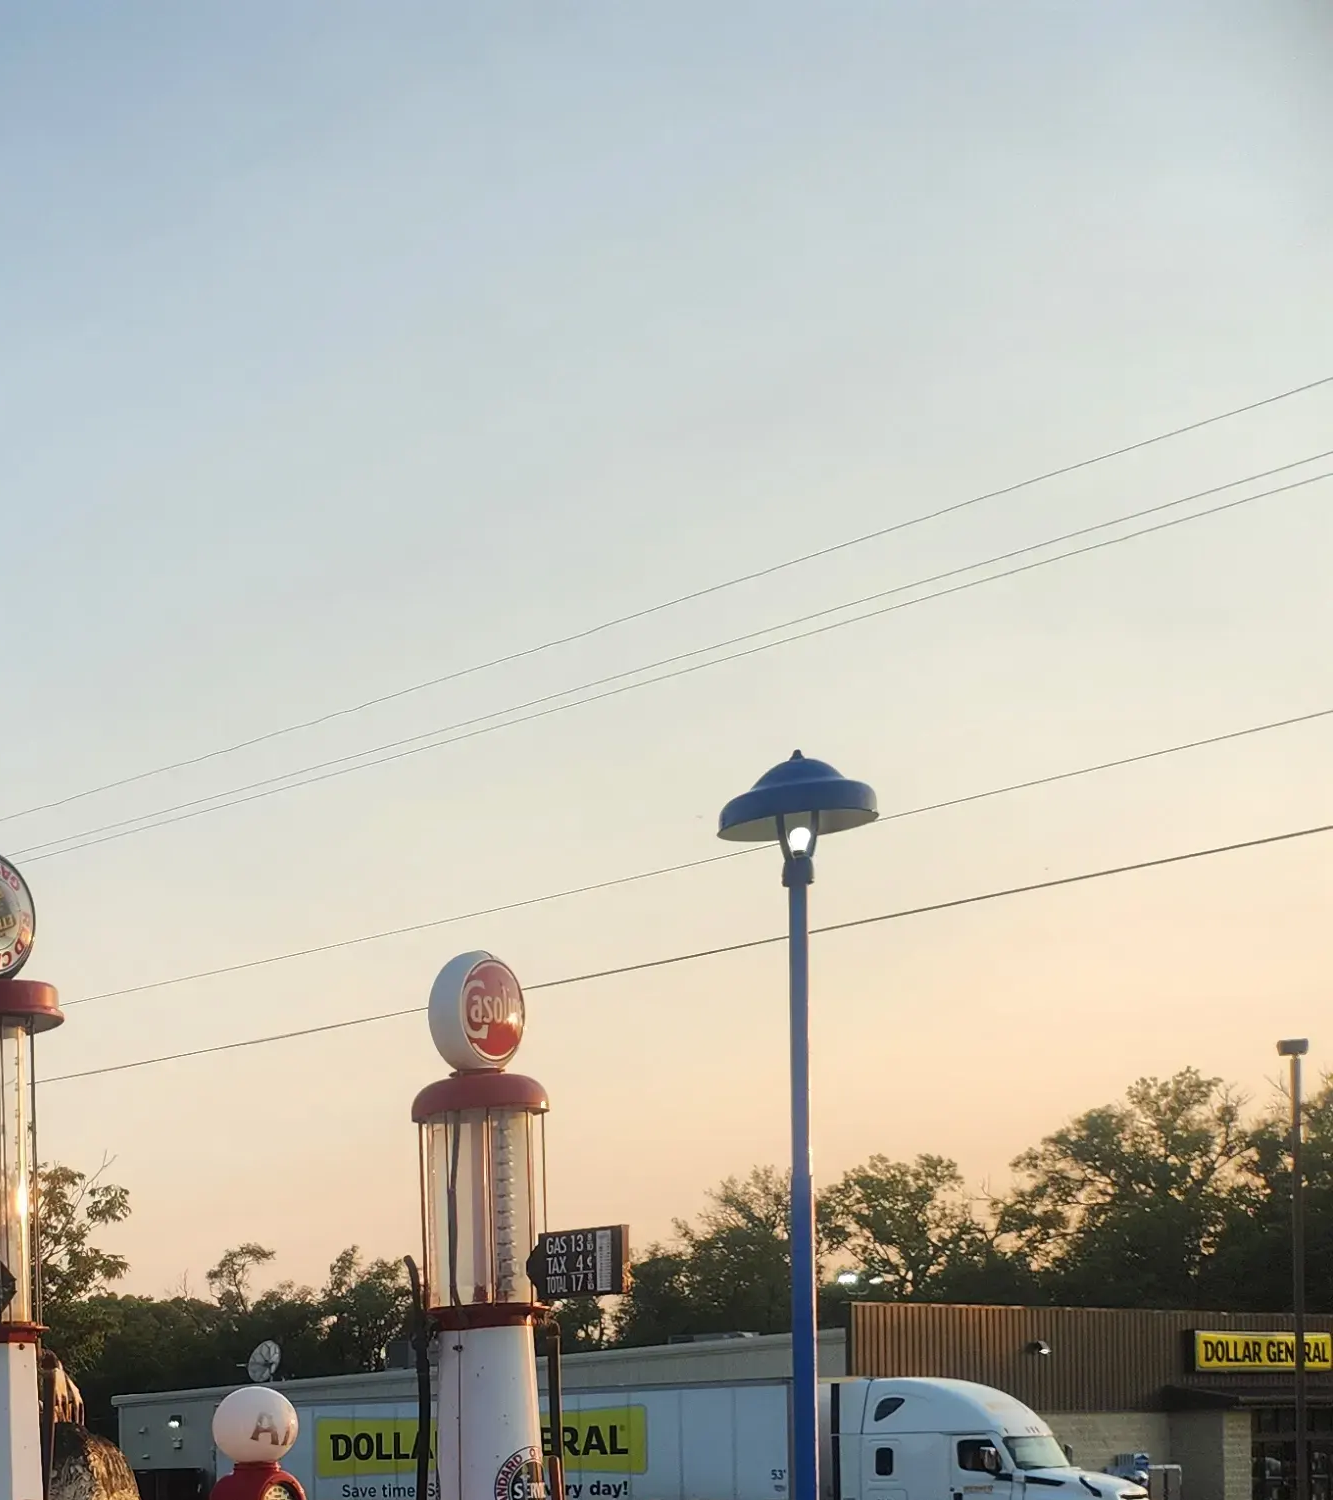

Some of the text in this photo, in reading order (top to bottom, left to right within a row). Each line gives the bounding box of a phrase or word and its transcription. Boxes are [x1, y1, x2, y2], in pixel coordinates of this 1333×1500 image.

[546, 1236, 567, 1255] GAS
[571, 1234, 584, 1252] 13
[546, 1256, 567, 1275] TAX
[546, 1275, 568, 1294] TOTAL
[571, 1274, 584, 1292] 17
[1203, 1340, 1330, 1363] DOLLAR GENRAL
[329, 1425, 629, 1461] DOLLA ERAL
[342, 1484, 377, 1498] Save
[589, 1480, 629, 1499] day!
